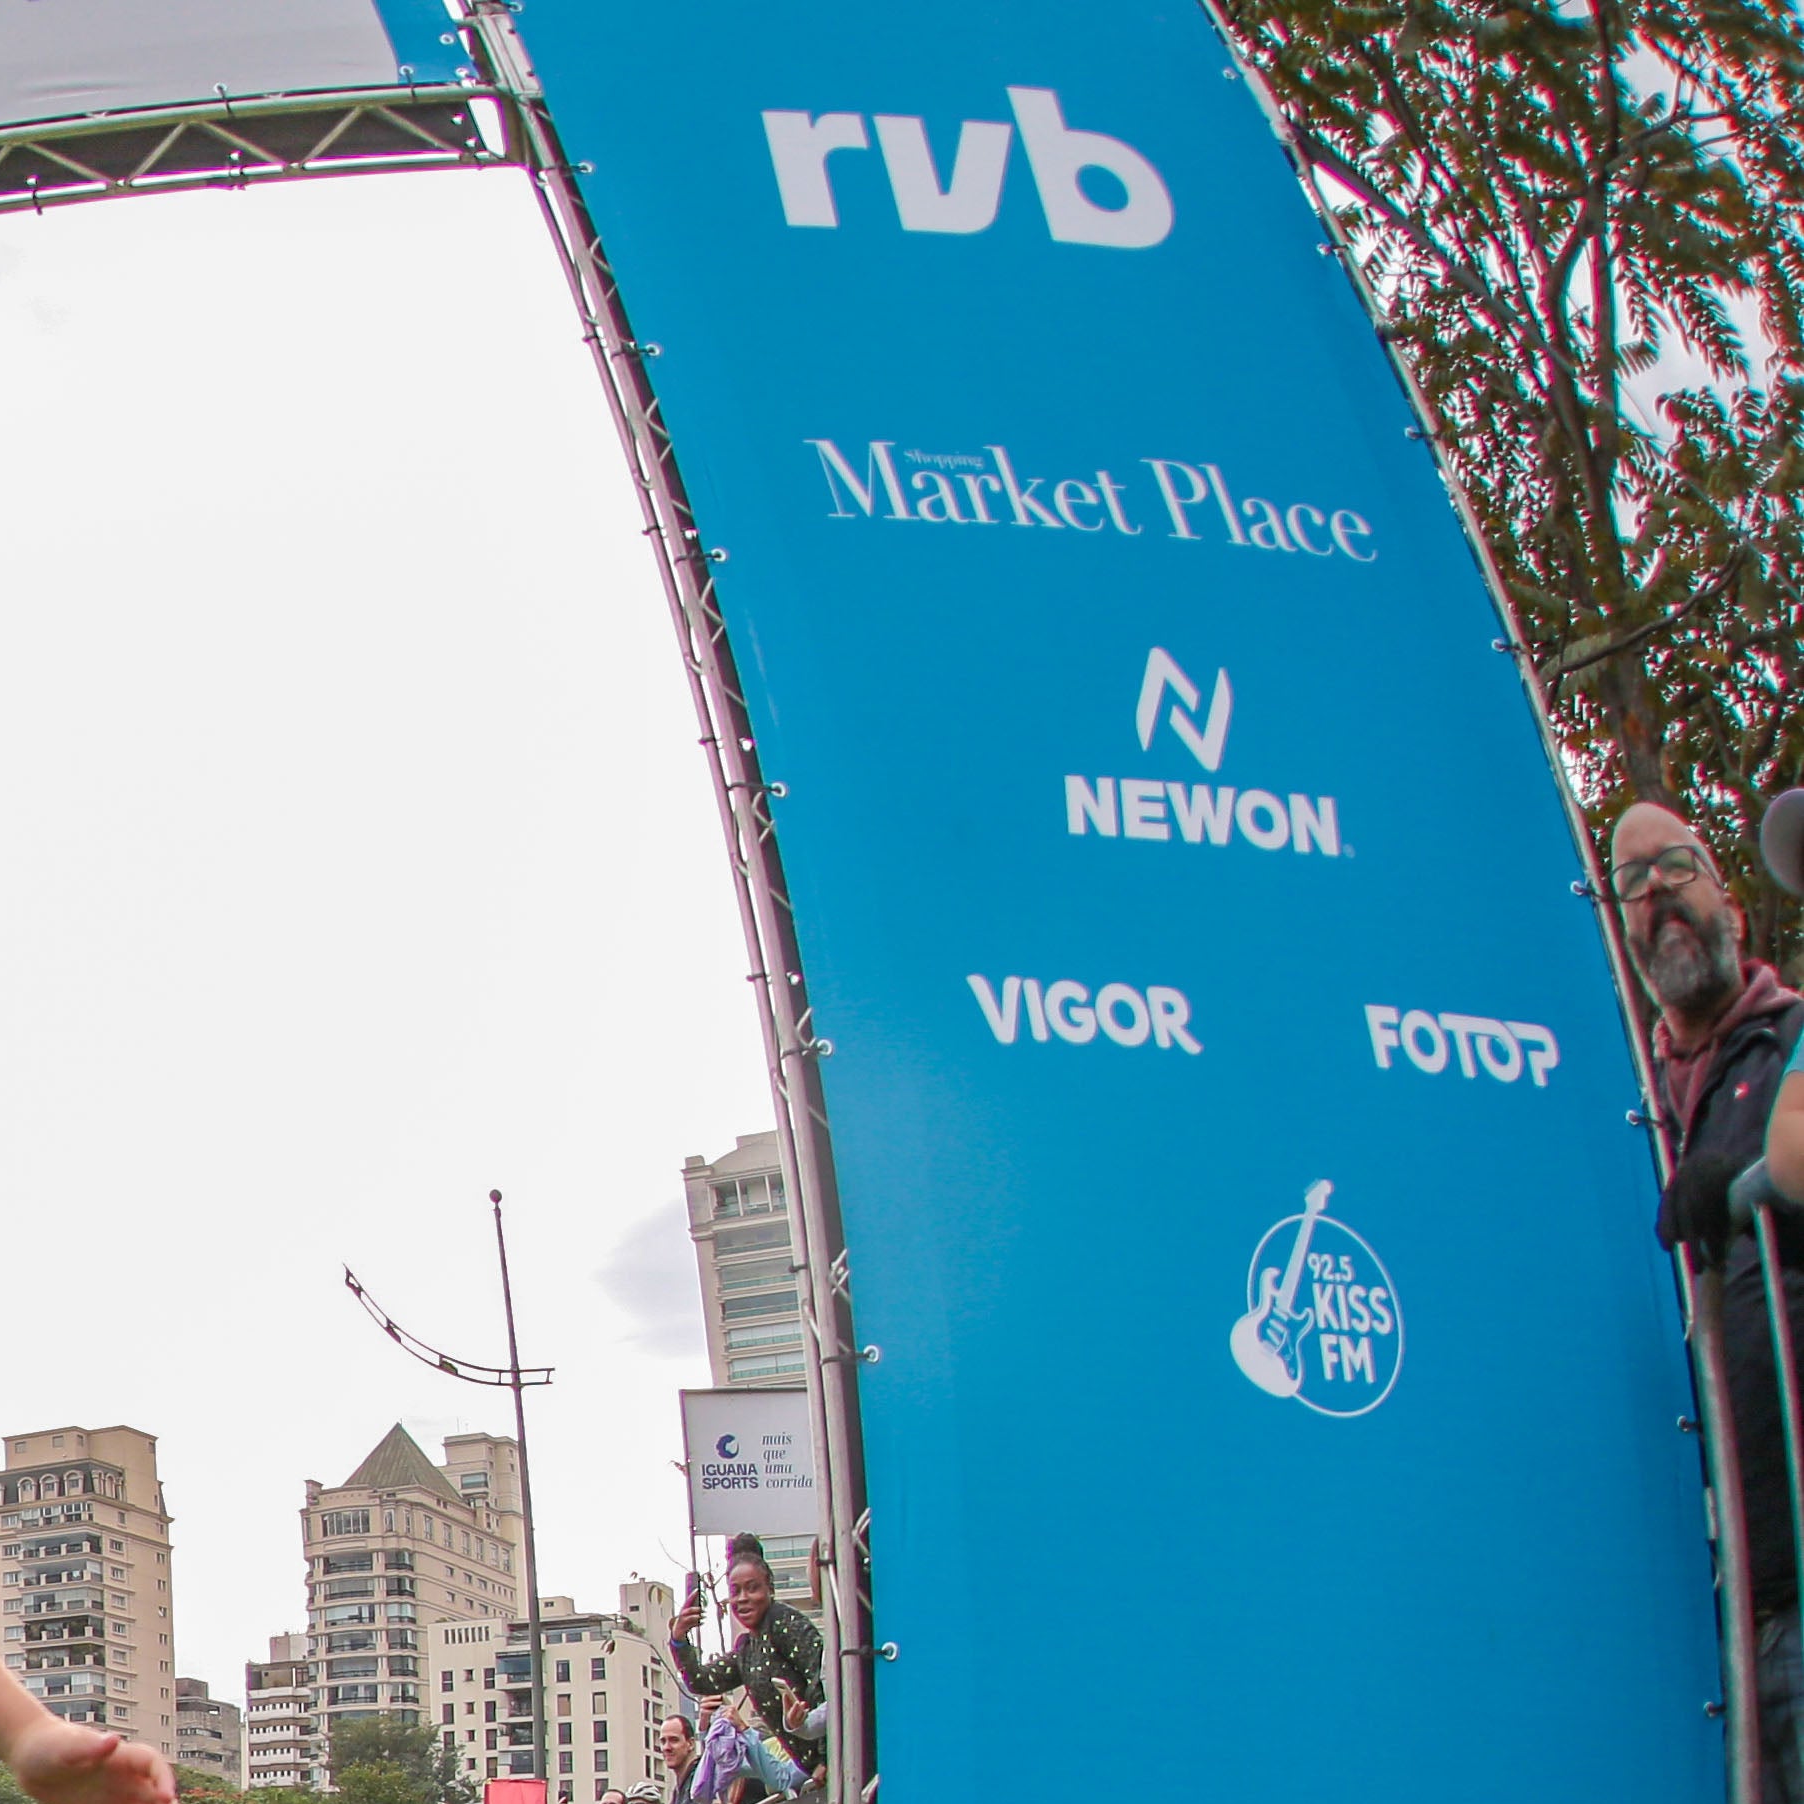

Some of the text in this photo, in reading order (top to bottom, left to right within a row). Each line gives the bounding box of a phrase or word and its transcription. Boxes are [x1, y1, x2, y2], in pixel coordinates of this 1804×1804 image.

[761, 86, 1174, 249] rvb
[803, 439, 1378, 562] Market Place
[1063, 774, 1341, 857] NEWON
[966, 973, 1203, 1054] VIGOR
[1307, 1252, 1354, 1282] 92.5
[1312, 1282, 1393, 1335] KISS
[1319, 1333, 1375, 1385] FM
[762, 1432, 792, 1446] mais
[702, 1463, 758, 1476] IGUANA
[763, 1449, 786, 1463] que
[765, 1464, 792, 1474] uma
[702, 1476, 759, 1490] SPORTS
[766, 1474, 813, 1489] corrida
